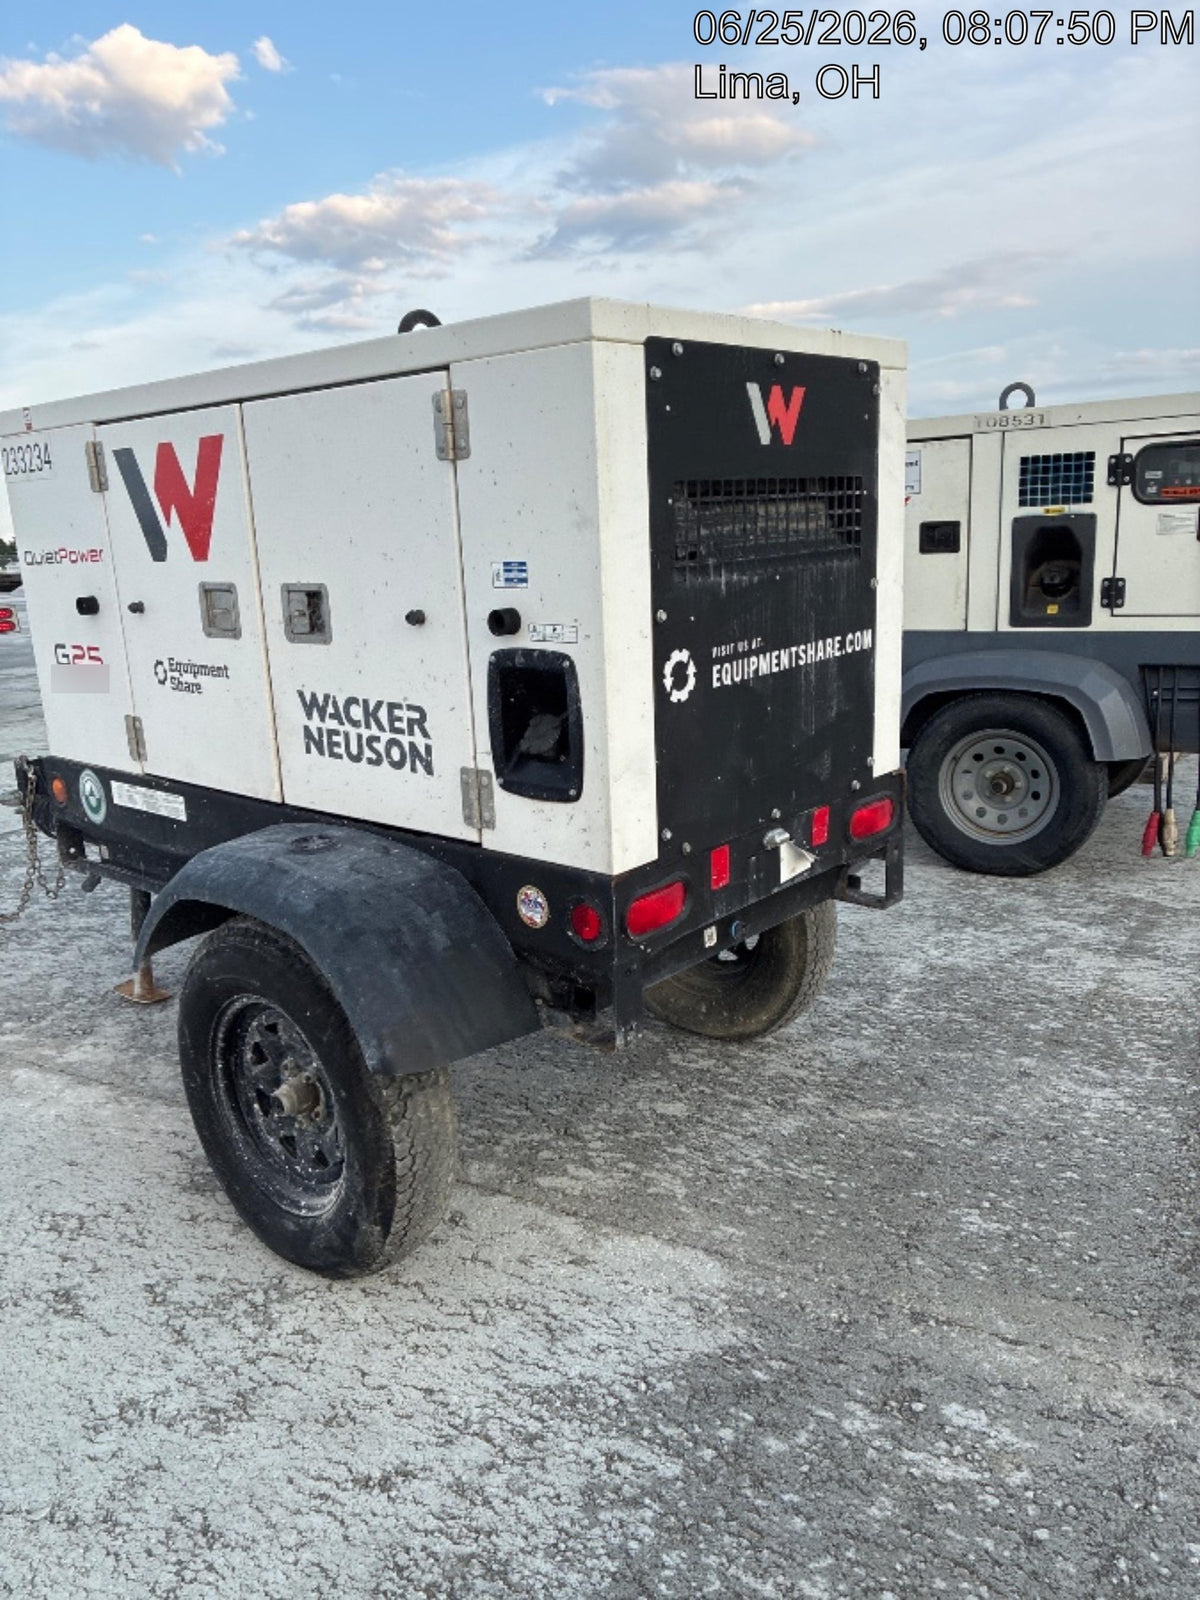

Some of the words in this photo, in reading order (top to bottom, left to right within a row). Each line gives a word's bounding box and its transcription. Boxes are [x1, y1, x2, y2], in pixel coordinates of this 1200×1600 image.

[1, 442, 52, 476] 233234
[24, 547, 104, 566] QuietPower
[54, 643, 104, 665] G25
[712, 642, 735, 659] VISIT
[737, 639, 749, 653] US
[712, 628, 873, 689] EQUIPMENTSHARE.COM
[168, 657, 230, 680] Equipment
[170, 676, 203, 695] Share
[296, 689, 432, 740] WACKER
[303, 724, 435, 777] NEUSON
